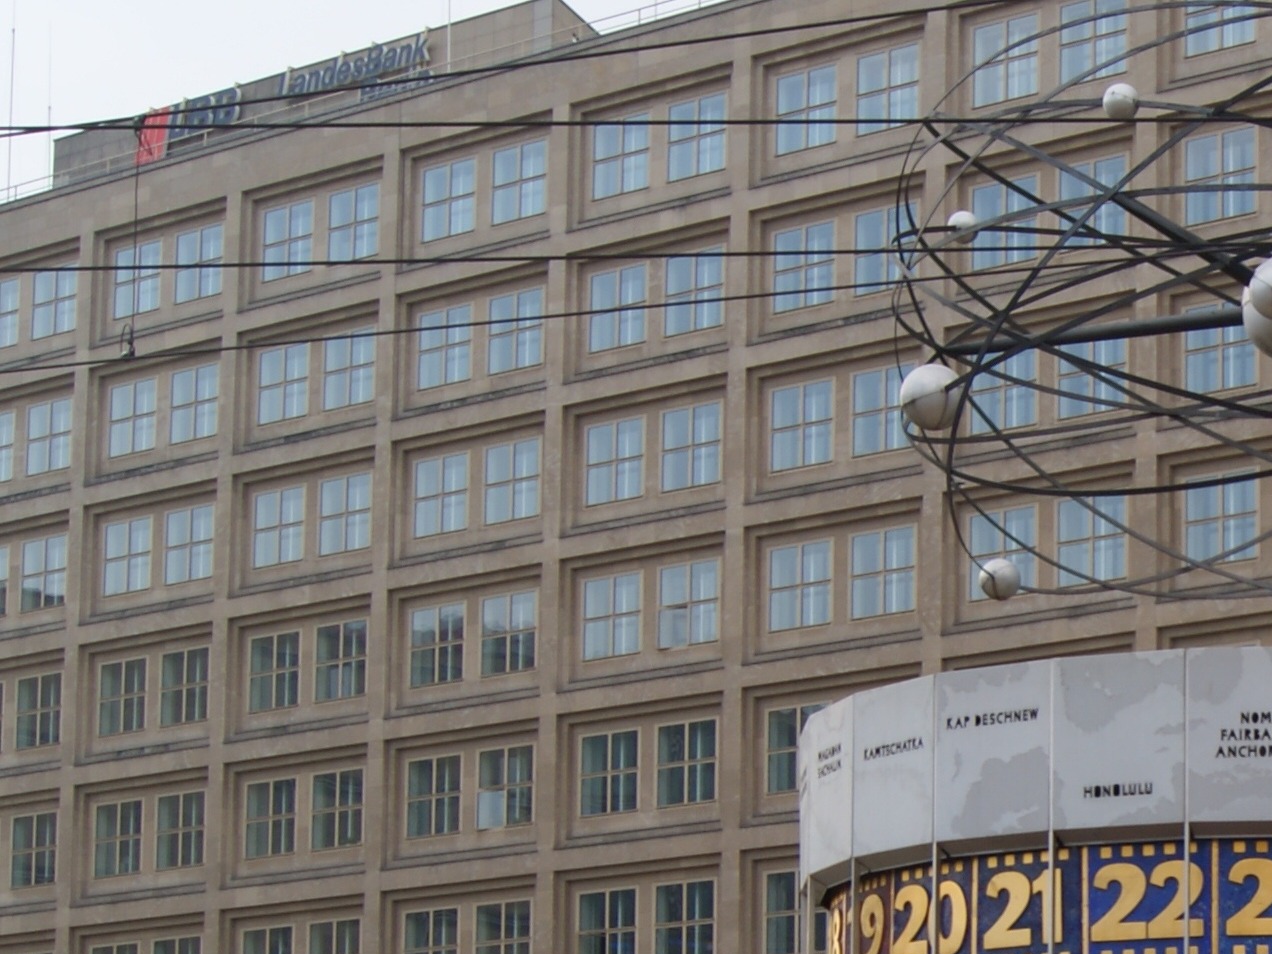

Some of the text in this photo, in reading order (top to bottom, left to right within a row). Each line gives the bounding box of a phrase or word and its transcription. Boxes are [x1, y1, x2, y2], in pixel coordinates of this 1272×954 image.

[277, 33, 431, 97] LandesBank
[946, 708, 1039, 730] KAP DESCHNEW
[863, 737, 924, 761] KAMTSCHATKA
[1083, 781, 1153, 799] HONOLULU
[983, 867, 1063, 949] 21
[1090, 860, 1204, 942] 22
